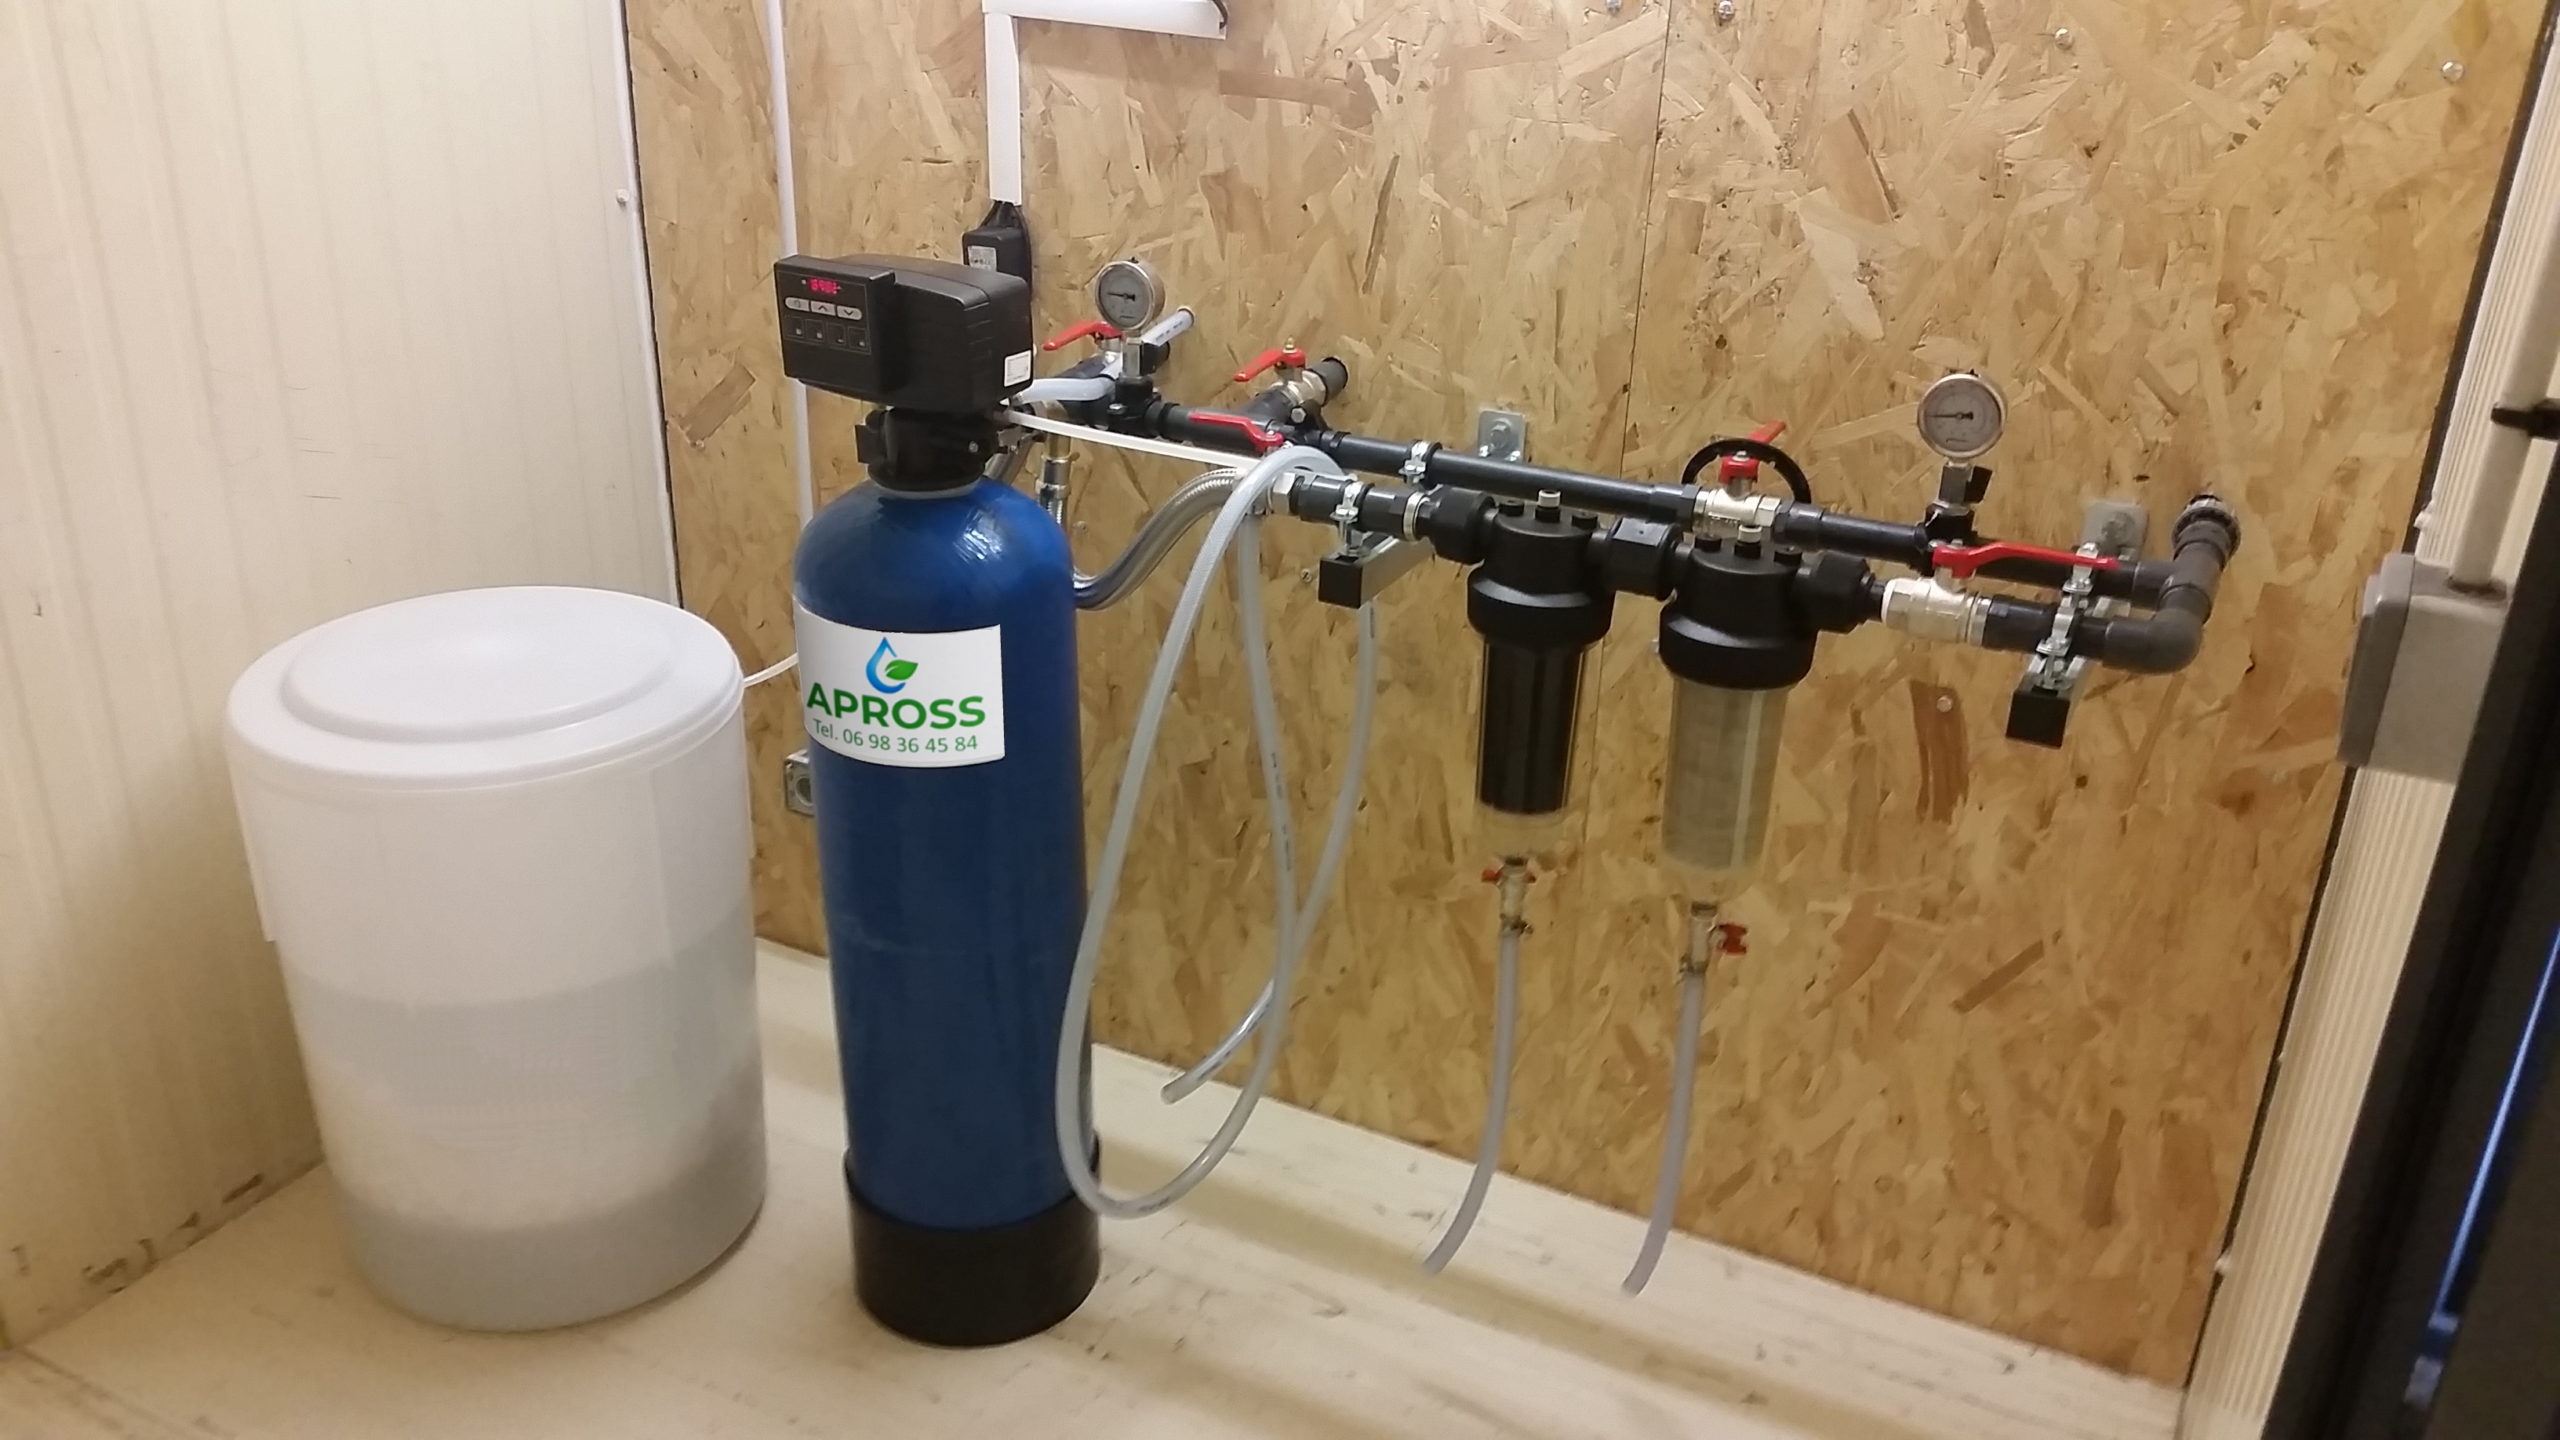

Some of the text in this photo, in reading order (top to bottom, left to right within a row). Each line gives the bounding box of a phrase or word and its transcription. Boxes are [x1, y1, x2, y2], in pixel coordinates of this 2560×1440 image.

[807, 682, 986, 730] APROSS
[813, 720, 978, 753] Tel. 06 98 36 45 84
